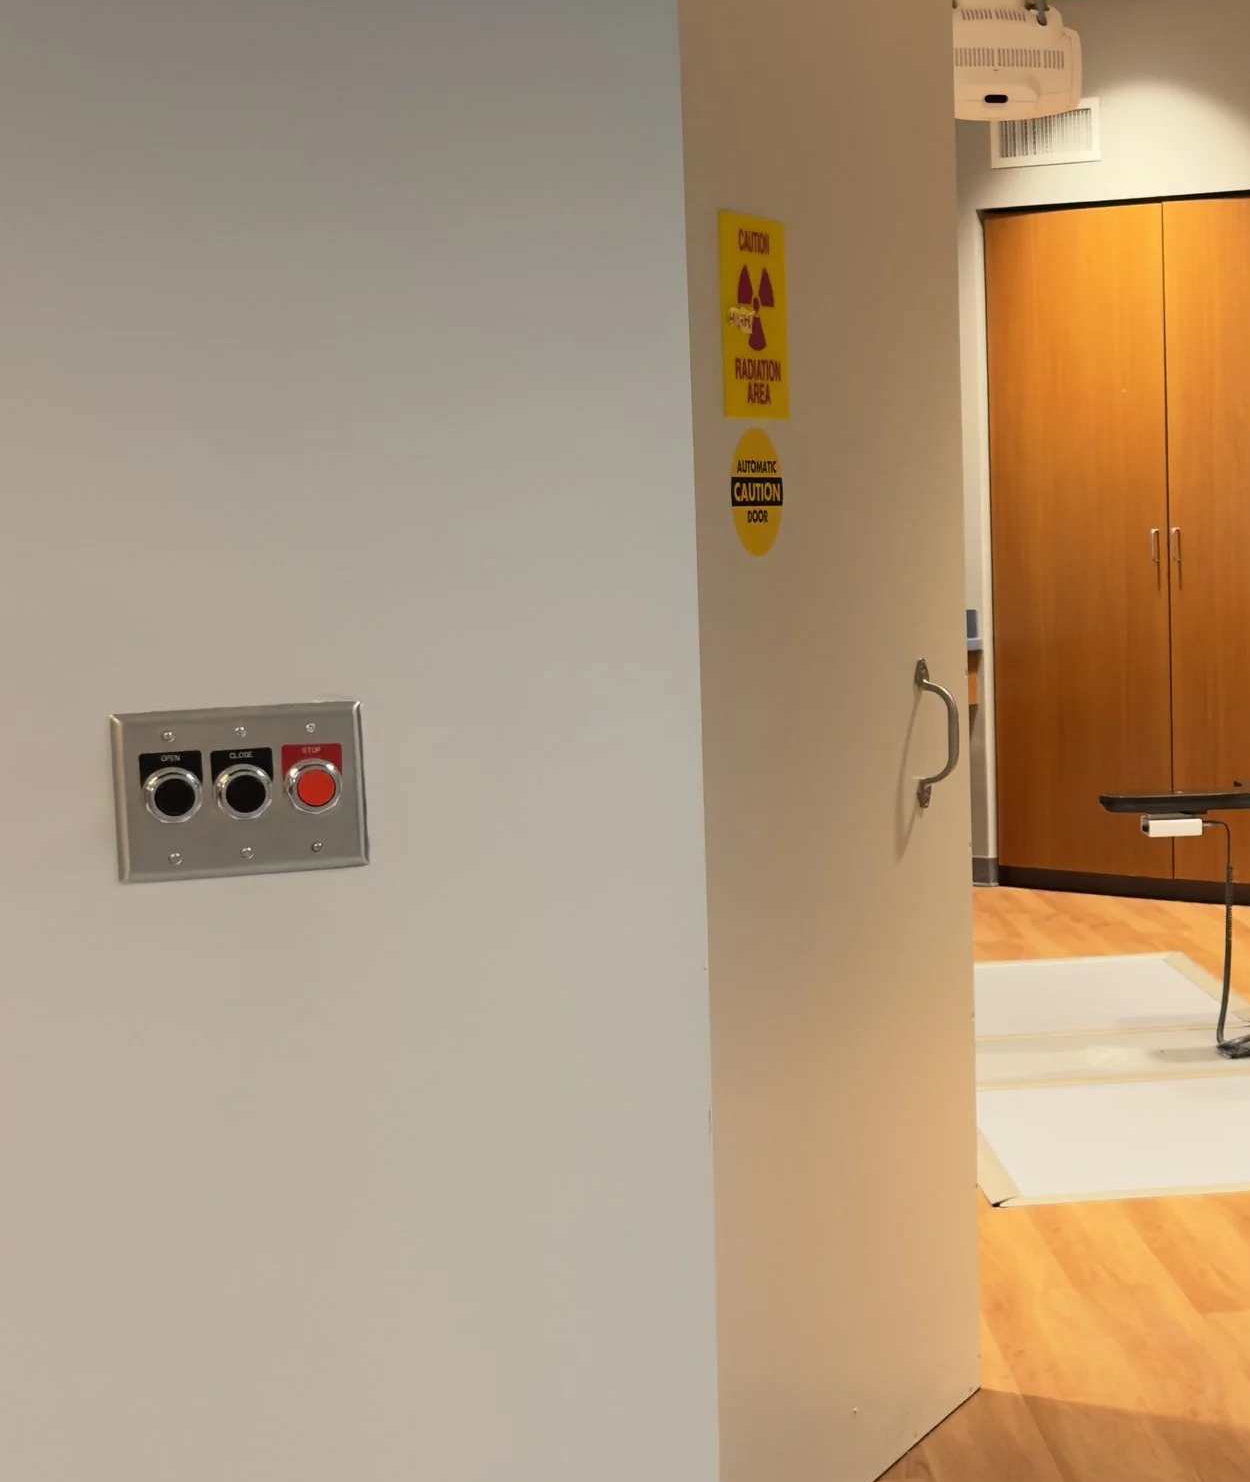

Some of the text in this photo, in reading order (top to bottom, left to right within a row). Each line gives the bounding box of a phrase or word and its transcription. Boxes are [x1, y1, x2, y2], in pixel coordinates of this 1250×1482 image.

[738, 228, 770, 255] CAUTION
[734, 357, 782, 382] RADIATION
[746, 382, 772, 406] AREA
[736, 459, 777, 473] AUTOMATIC
[733, 481, 781, 503] CAUTION
[746, 509, 769, 524] DOOR
[160, 754, 181, 762] OPEN
[229, 750, 254, 759] CLOSE
[302, 746, 321, 755] STOP
